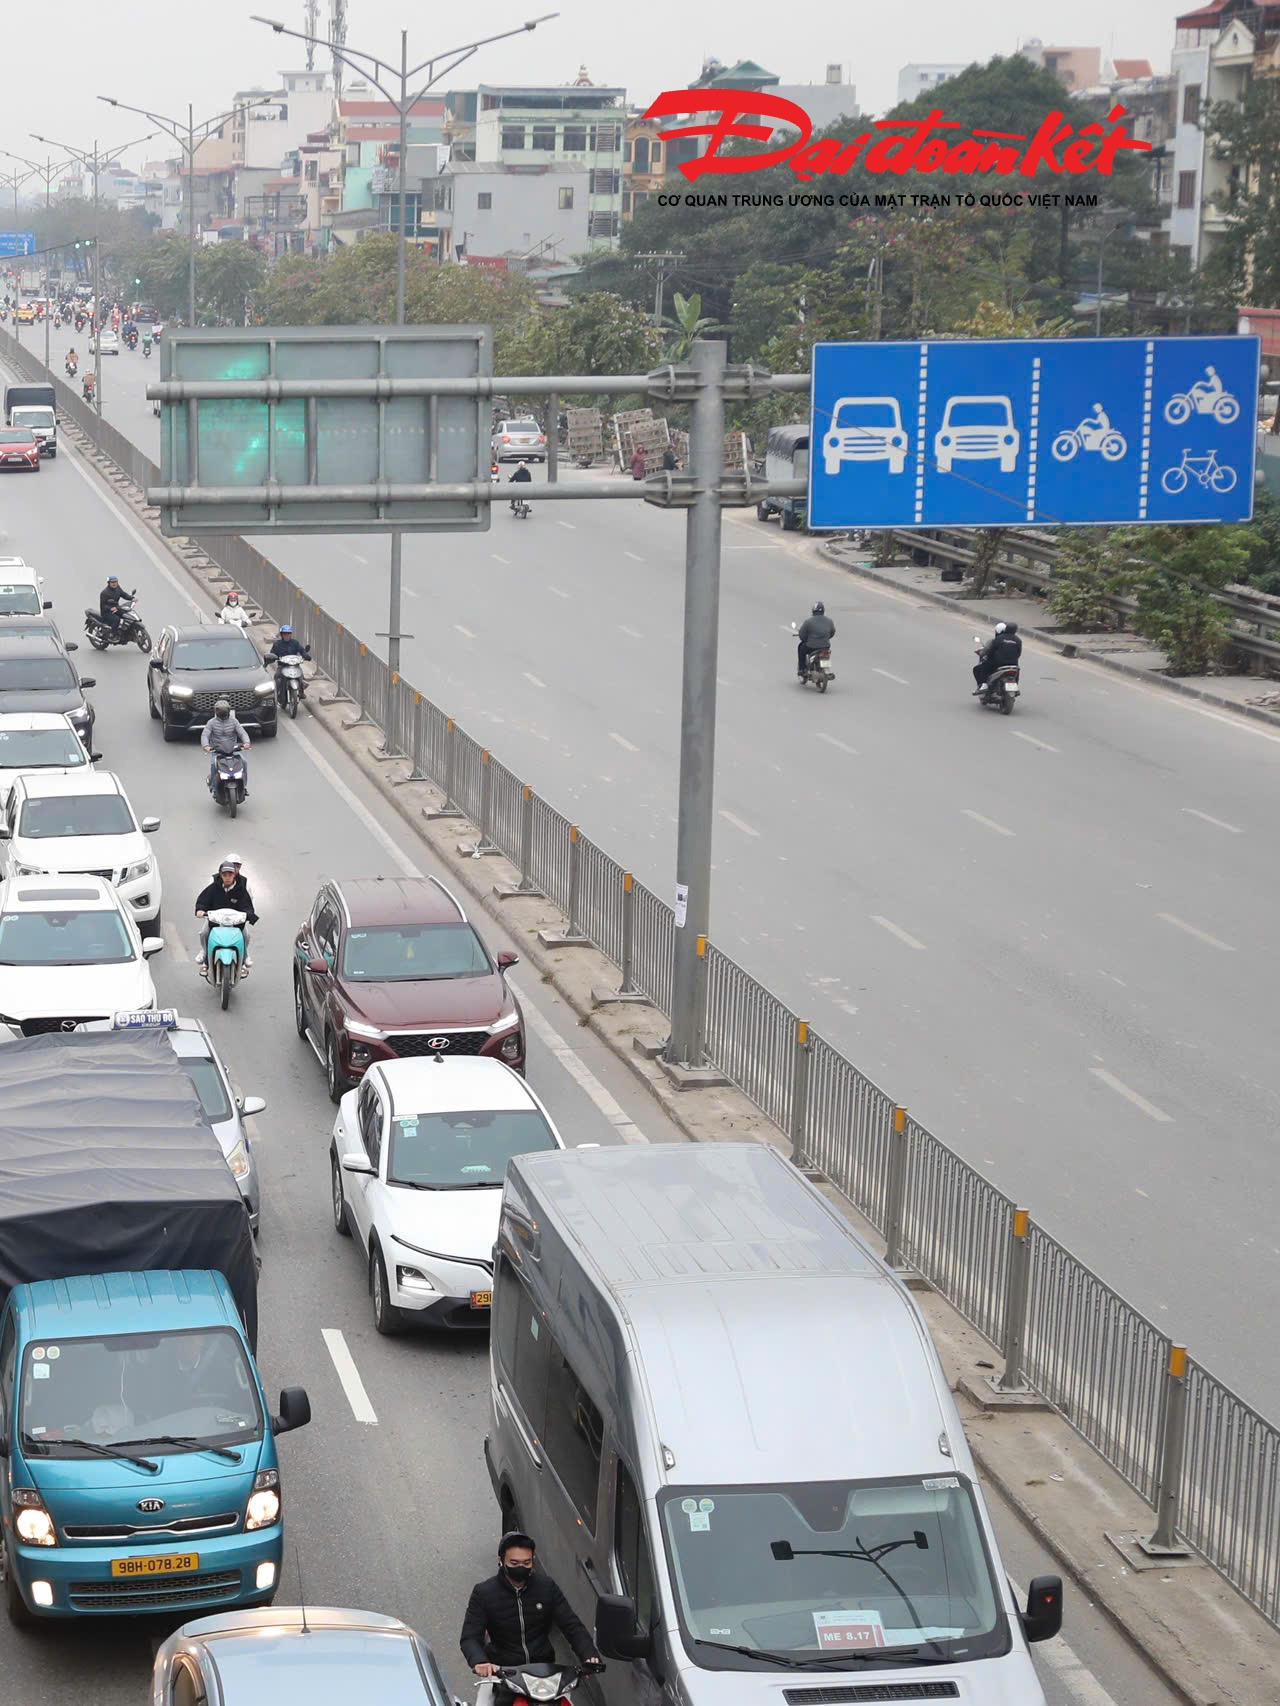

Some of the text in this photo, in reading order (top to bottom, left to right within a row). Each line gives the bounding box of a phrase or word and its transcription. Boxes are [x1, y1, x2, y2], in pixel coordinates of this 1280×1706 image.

[130, 1014, 146, 1024] SAO
[477, 1293, 492, 1303] 29
[140, 1501, 161, 1511] KIA
[118, 1556, 192, 1573] 98H-078.28
[823, 1631, 870, 1641] ME 8.17
